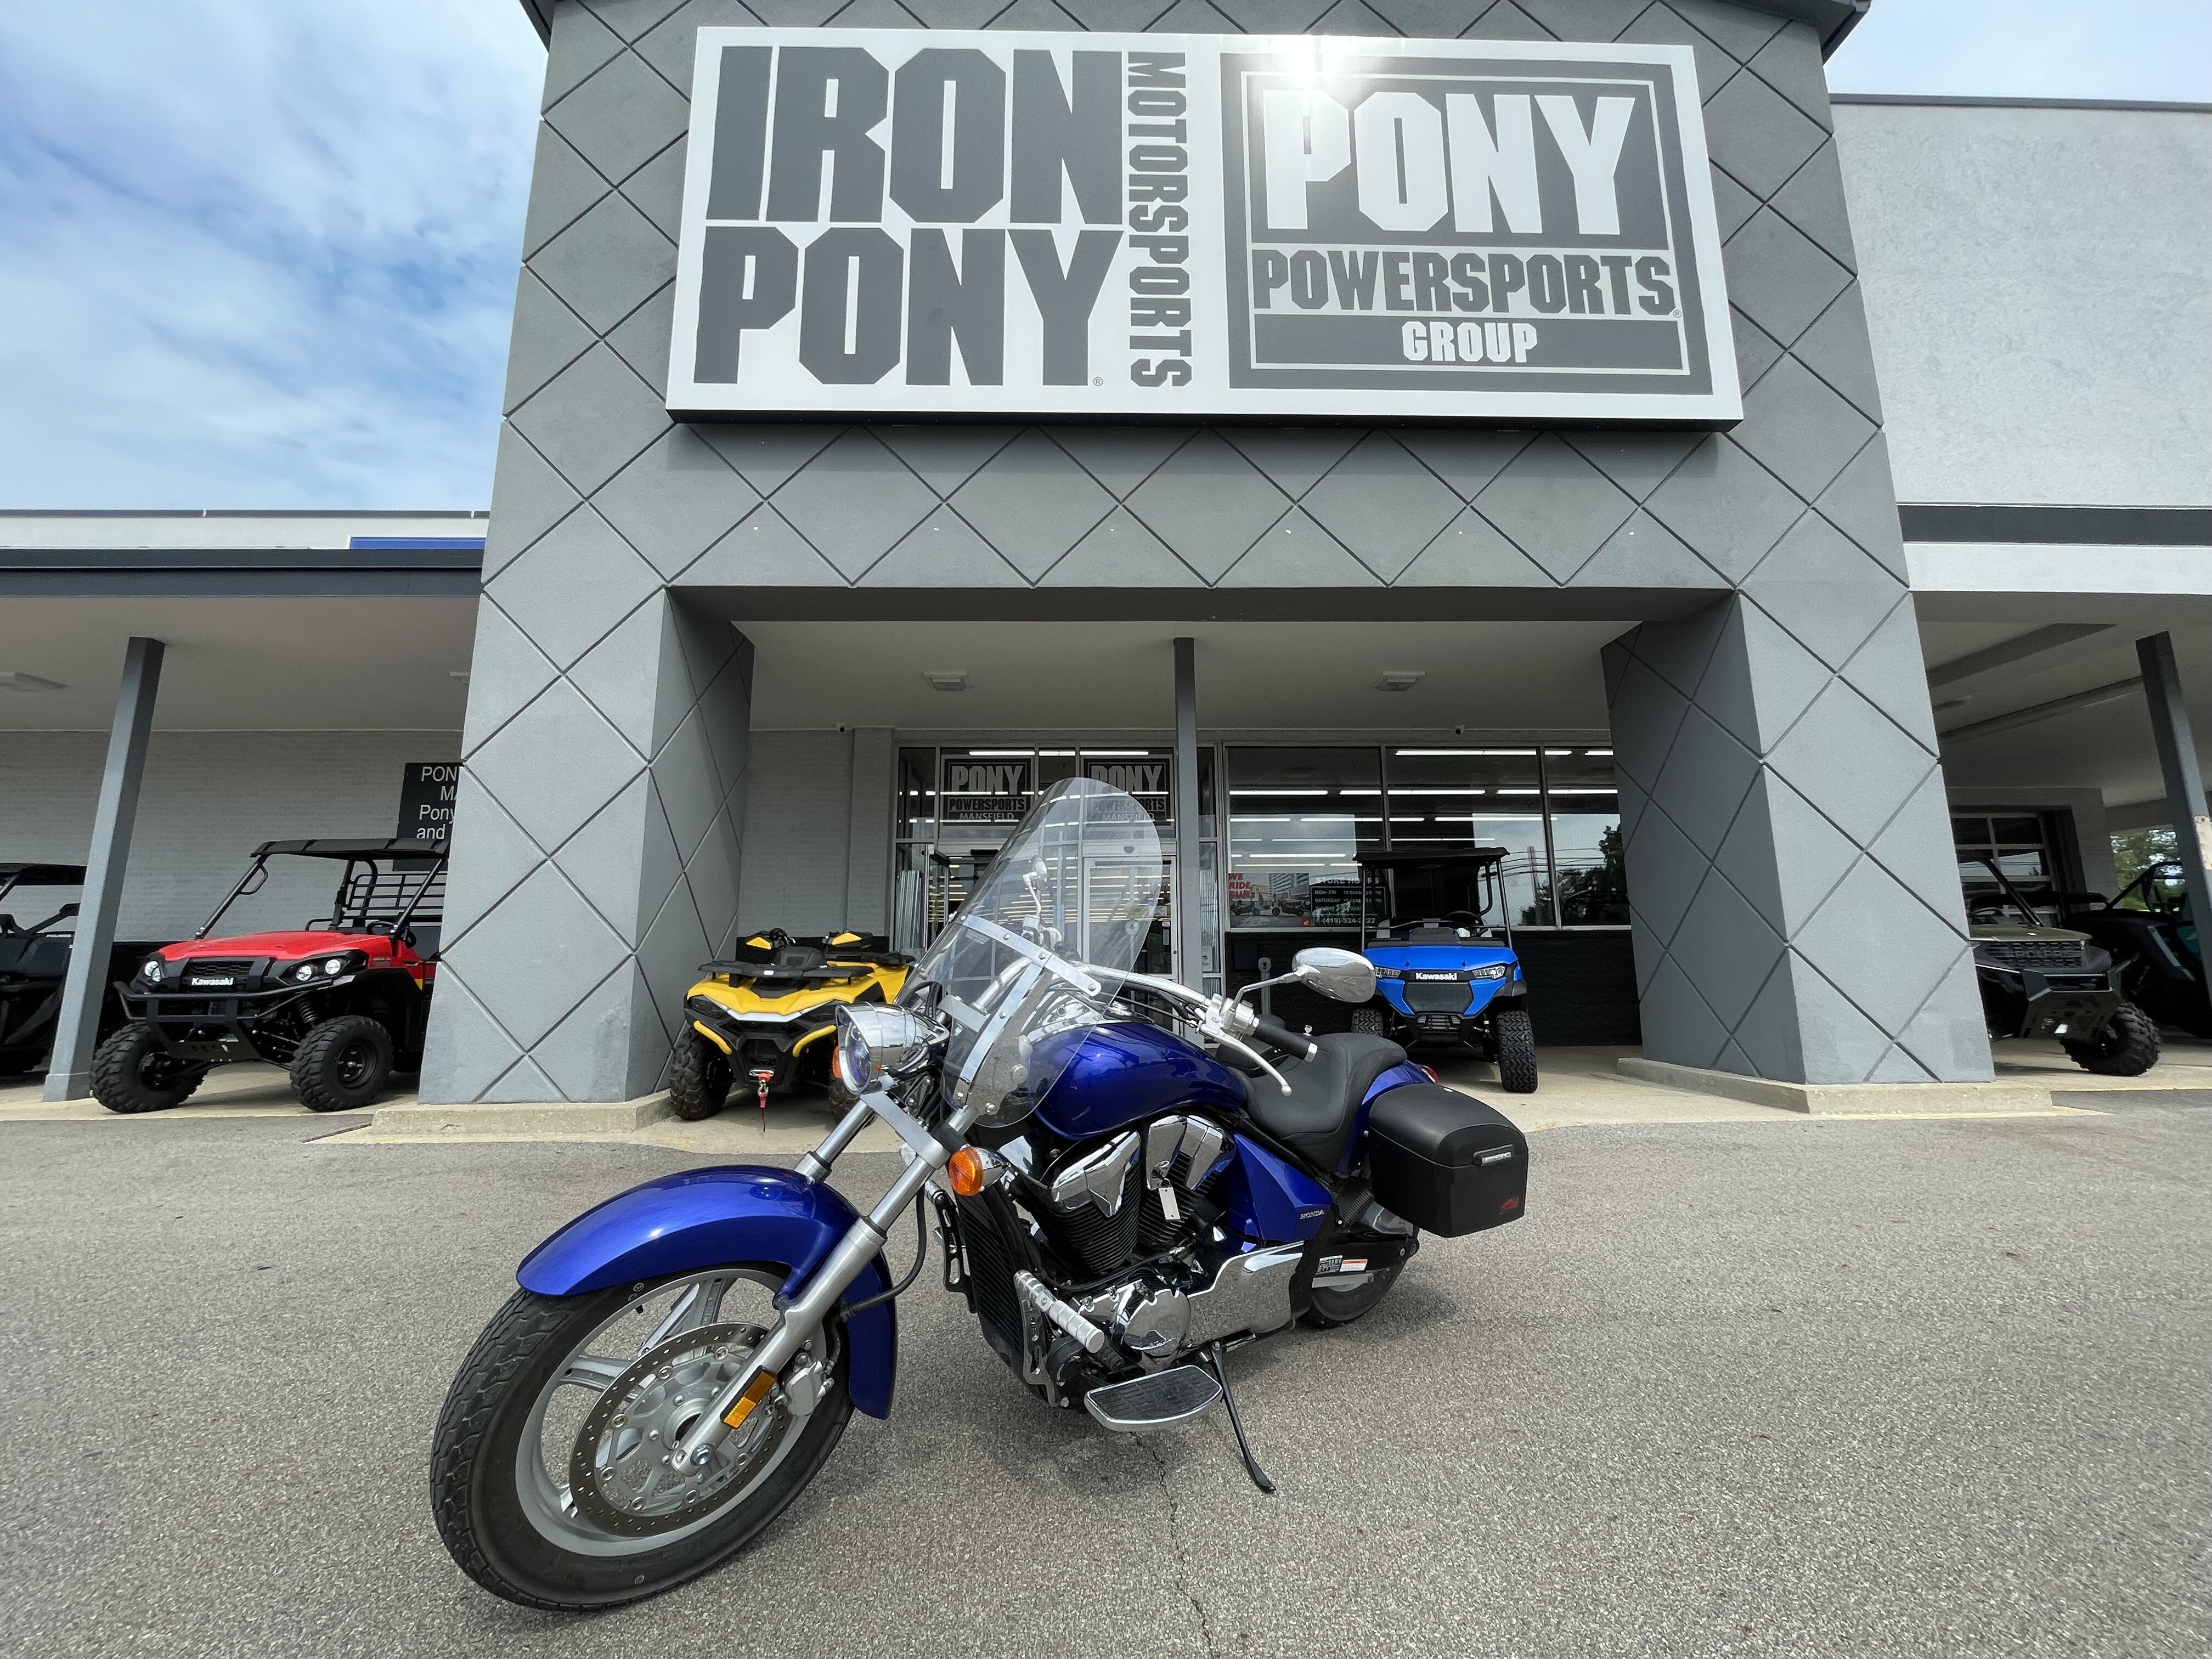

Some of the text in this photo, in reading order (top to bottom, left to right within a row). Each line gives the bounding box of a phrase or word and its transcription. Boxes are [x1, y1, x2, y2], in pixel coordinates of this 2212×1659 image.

[706, 46, 1123, 224] IRON
[1262, 89, 1635, 235] PONY
[1128, 51, 1193, 387] MOTORSPORTS
[1252, 249, 1676, 315] POWERSPORTS
[693, 226, 1124, 386] PONY
[1402, 321, 1538, 363] GROUP
[421, 766, 459, 782] PON
[952, 765, 1024, 795] PONY
[440, 786, 456, 801] M
[949, 798, 1025, 811] POWERSPORTS
[960, 812, 1015, 821] MANSFIELD
[416, 823, 445, 839] and
[191, 977, 234, 985] Kawasaki
[1415, 972, 1457, 980] Kawasaki
[1300, 1210, 1325, 1220] HONDA
